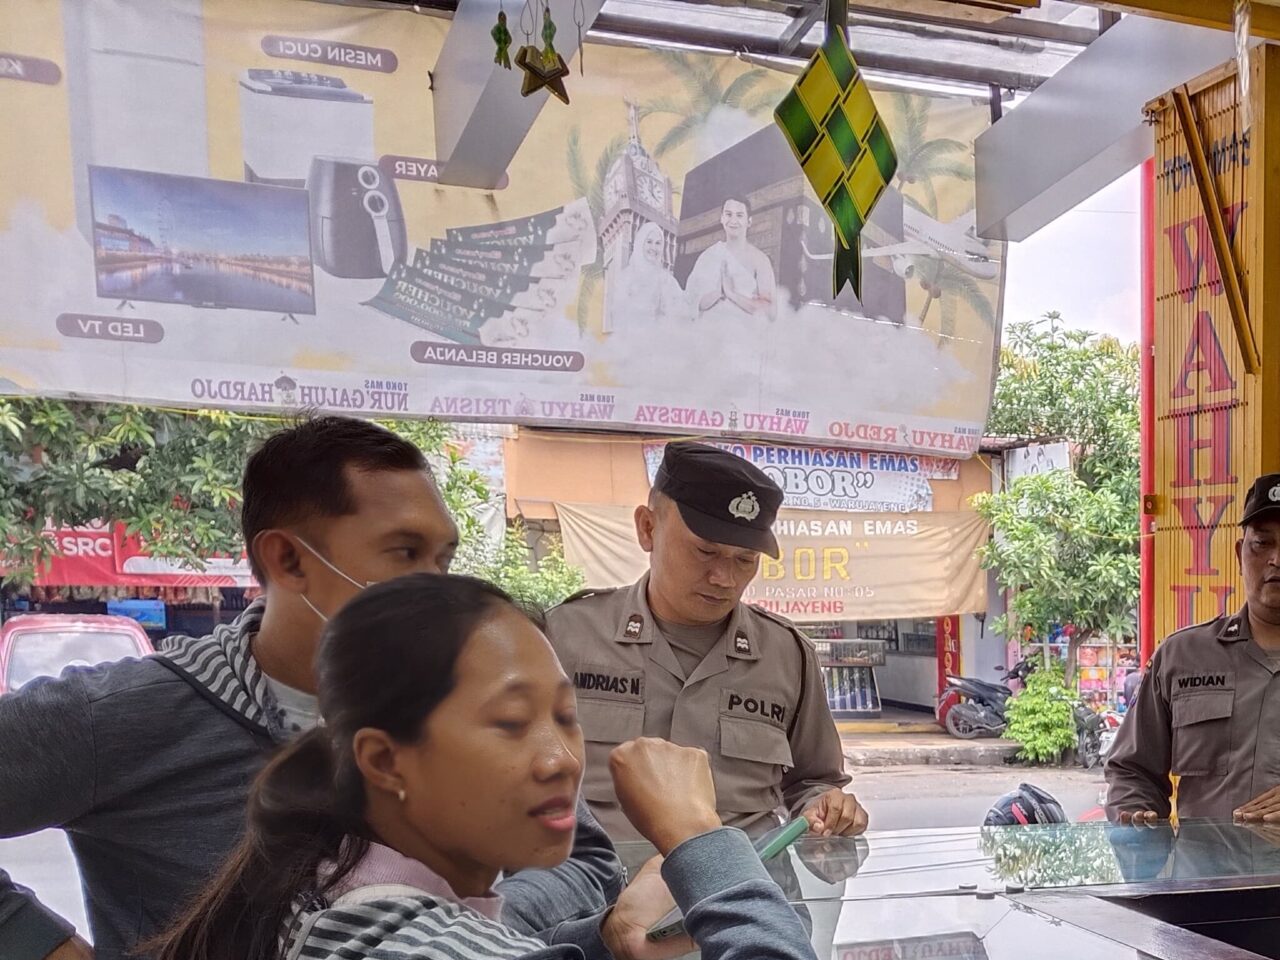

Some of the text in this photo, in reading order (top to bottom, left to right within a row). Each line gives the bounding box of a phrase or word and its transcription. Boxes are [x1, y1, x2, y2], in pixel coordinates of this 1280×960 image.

[752, 446, 862, 470] PERHIASAN
[868, 453, 920, 474] EMAS
[863, 519, 918, 536] EMAS
[63, 536, 112, 557] SRC
[765, 586, 817, 598] PASAR
[854, 586, 875, 598] 05
[573, 671, 640, 696] ANDRIAS N
[1177, 675, 1226, 689] WIDIAN
[728, 693, 786, 724] POLRI
